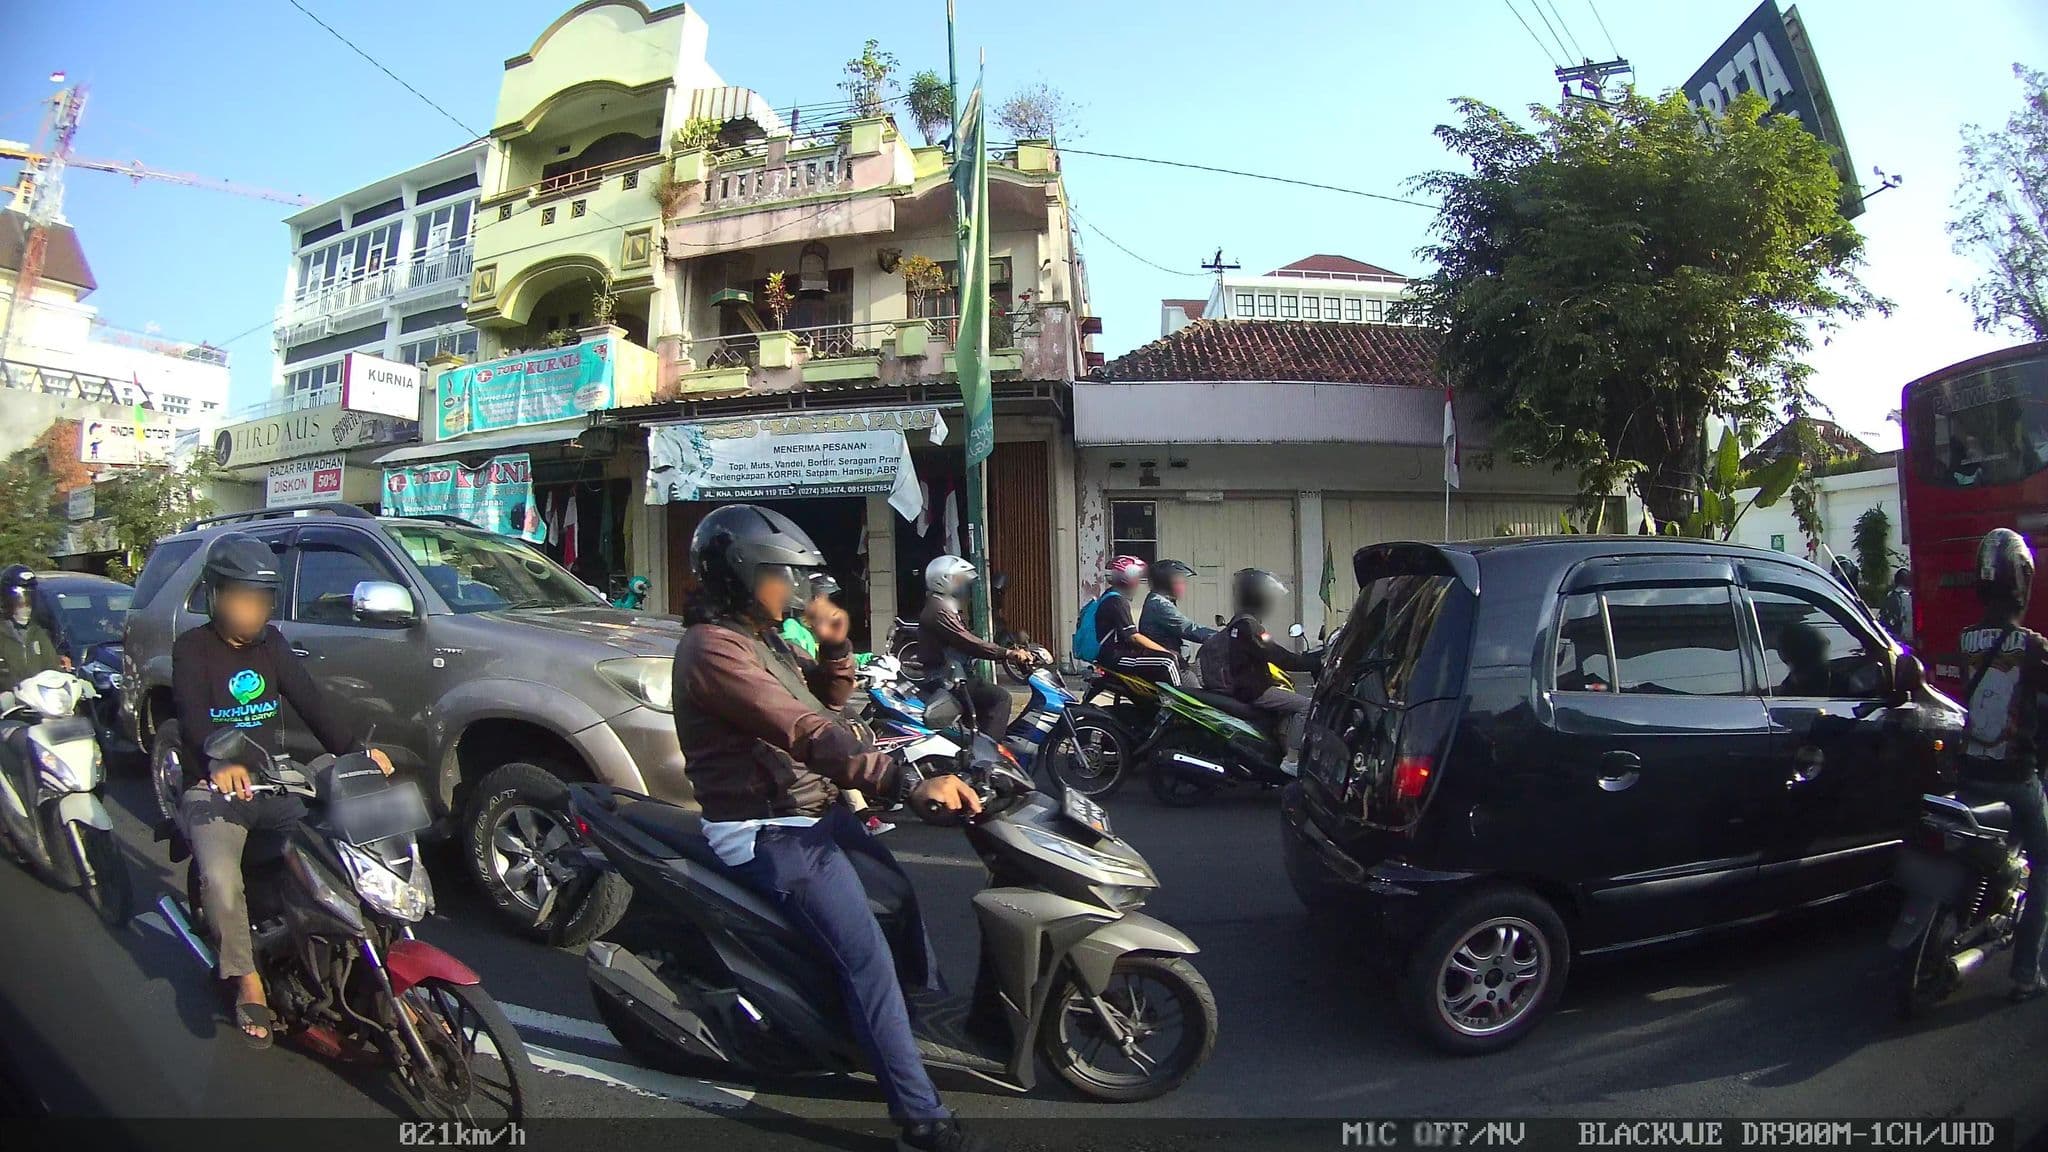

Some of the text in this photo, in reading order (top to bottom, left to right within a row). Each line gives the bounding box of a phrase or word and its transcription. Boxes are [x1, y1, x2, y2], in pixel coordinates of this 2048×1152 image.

[497, 353, 581, 376] TOKO KURNIA
[368, 368, 414, 389] KURNIA
[138, 427, 170, 439] OTOR
[235, 414, 322, 451] FIRDAUS
[773, 444, 820, 454] MENERIMA
[822, 441, 867, 451] PESANAN
[269, 455, 343, 478] BAZAR RAMADHAN
[729, 462, 749, 471] Topi,
[750, 461, 773, 470] Muts,
[775, 459, 806, 469] Vandel,
[807, 458, 836, 467] Bordir,
[838, 456, 877, 467] Seragam
[413, 469, 452, 486] TOKO
[710, 472, 765, 483] Perlengkapan
[842, 467, 875, 477] Hansip,
[274, 473, 338, 494] DISKON 50%
[734, 489, 765, 497] DAHLAN
[235, 720, 263, 728] JOGJA
